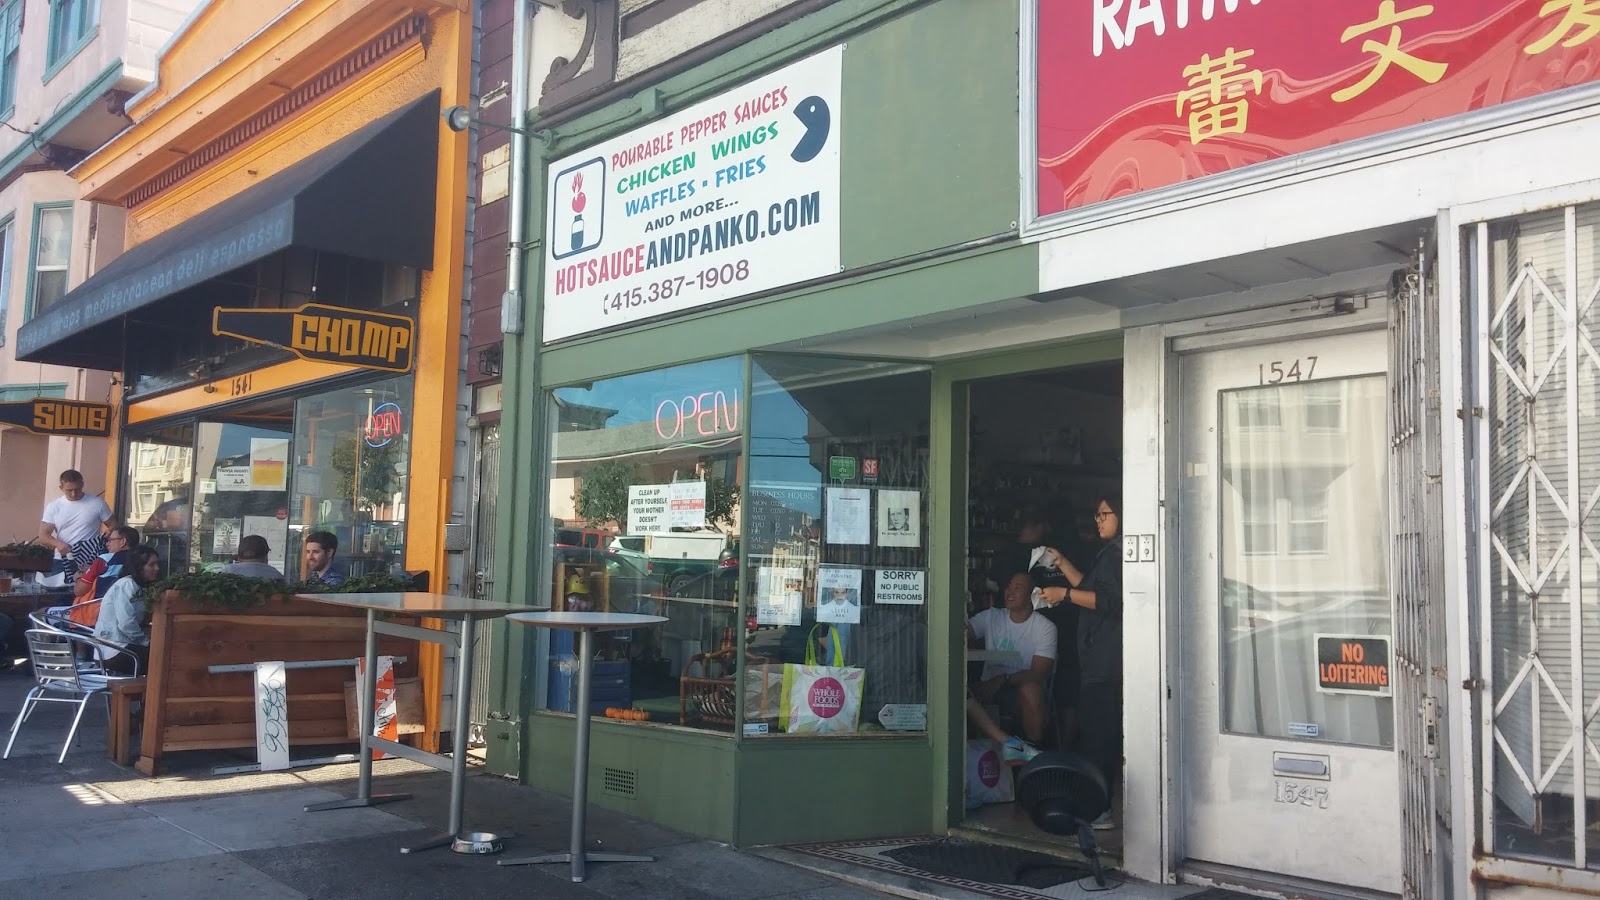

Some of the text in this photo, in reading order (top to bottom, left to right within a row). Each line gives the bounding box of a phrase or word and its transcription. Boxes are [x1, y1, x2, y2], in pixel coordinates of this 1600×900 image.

[611, 86, 788, 172] POURABLE PEPPER SAUCES
[616, 120, 779, 194] CHICKEN WINGS
[625, 154, 766, 218] WAFFLES FRIES
[644, 198, 739, 233] AND MORE...
[177, 249, 205, 281] deli
[211, 218, 284, 267] espresso
[555, 190, 820, 296] HOTSAUCEANDPANKO.COM
[291, 313, 410, 363] CHOMP
[1259, 356, 1318, 384] 1547
[230, 374, 252, 397] 1541
[33, 403, 108, 432] SWIG
[365, 411, 401, 439] OPEN
[655, 388, 738, 440] OPEN
[865, 460, 877, 474] SF
[752, 490, 815, 500] BUSINESS HOURS
[882, 571, 918, 580] SORRY
[1342, 643, 1364, 663] NO
[1320, 663, 1387, 686] LOITERING
[814, 688, 840, 696] WHOLE
[814, 696, 840, 704] FOODS
[1273, 780, 1329, 809] 1547
